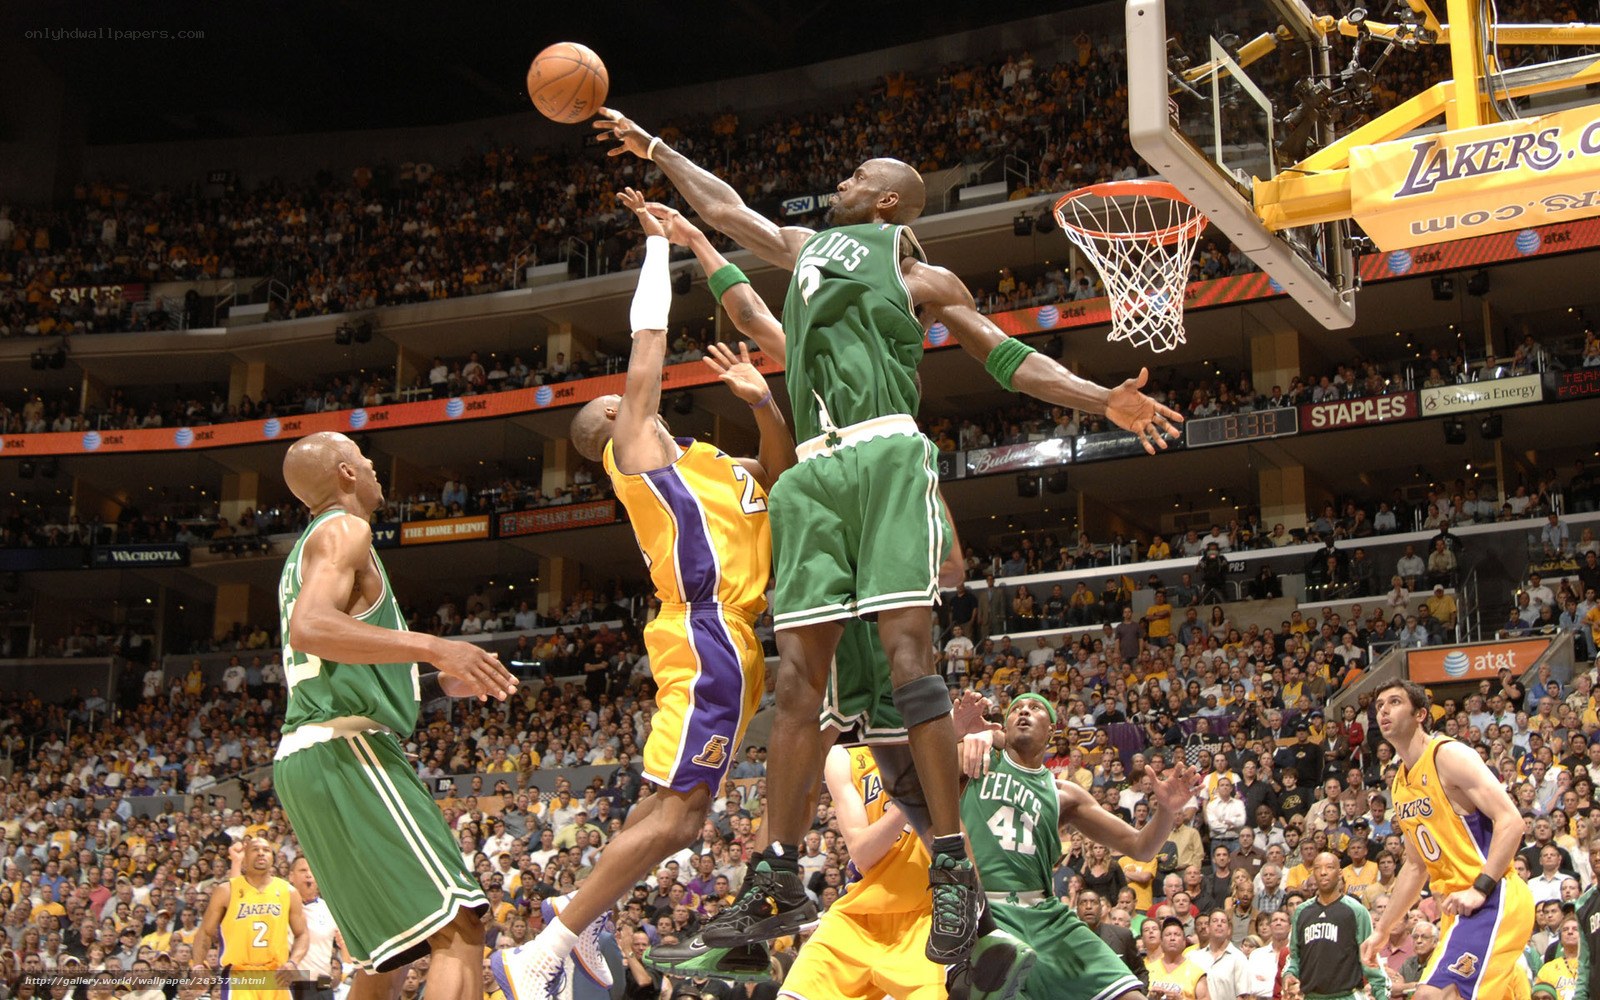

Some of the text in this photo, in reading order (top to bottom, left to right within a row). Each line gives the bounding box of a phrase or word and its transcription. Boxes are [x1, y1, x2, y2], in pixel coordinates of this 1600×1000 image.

[787, 197, 810, 212] FSN
[1493, 384, 1538, 399] Energy
[1311, 395, 1407, 428] STAPLES
[731, 464, 768, 514] 2
[403, 527, 424, 539] THE
[425, 525, 454, 537] HOME
[455, 521, 488, 534] DEPOT
[112, 551, 181, 561] WACHOVIA
[1474, 649, 1516, 671] at&t
[986, 805, 1037, 855] 41
[236, 903, 282, 920] LAKERS
[252, 921, 269, 948] 2
[1304, 922, 1338, 945] BOSTON
